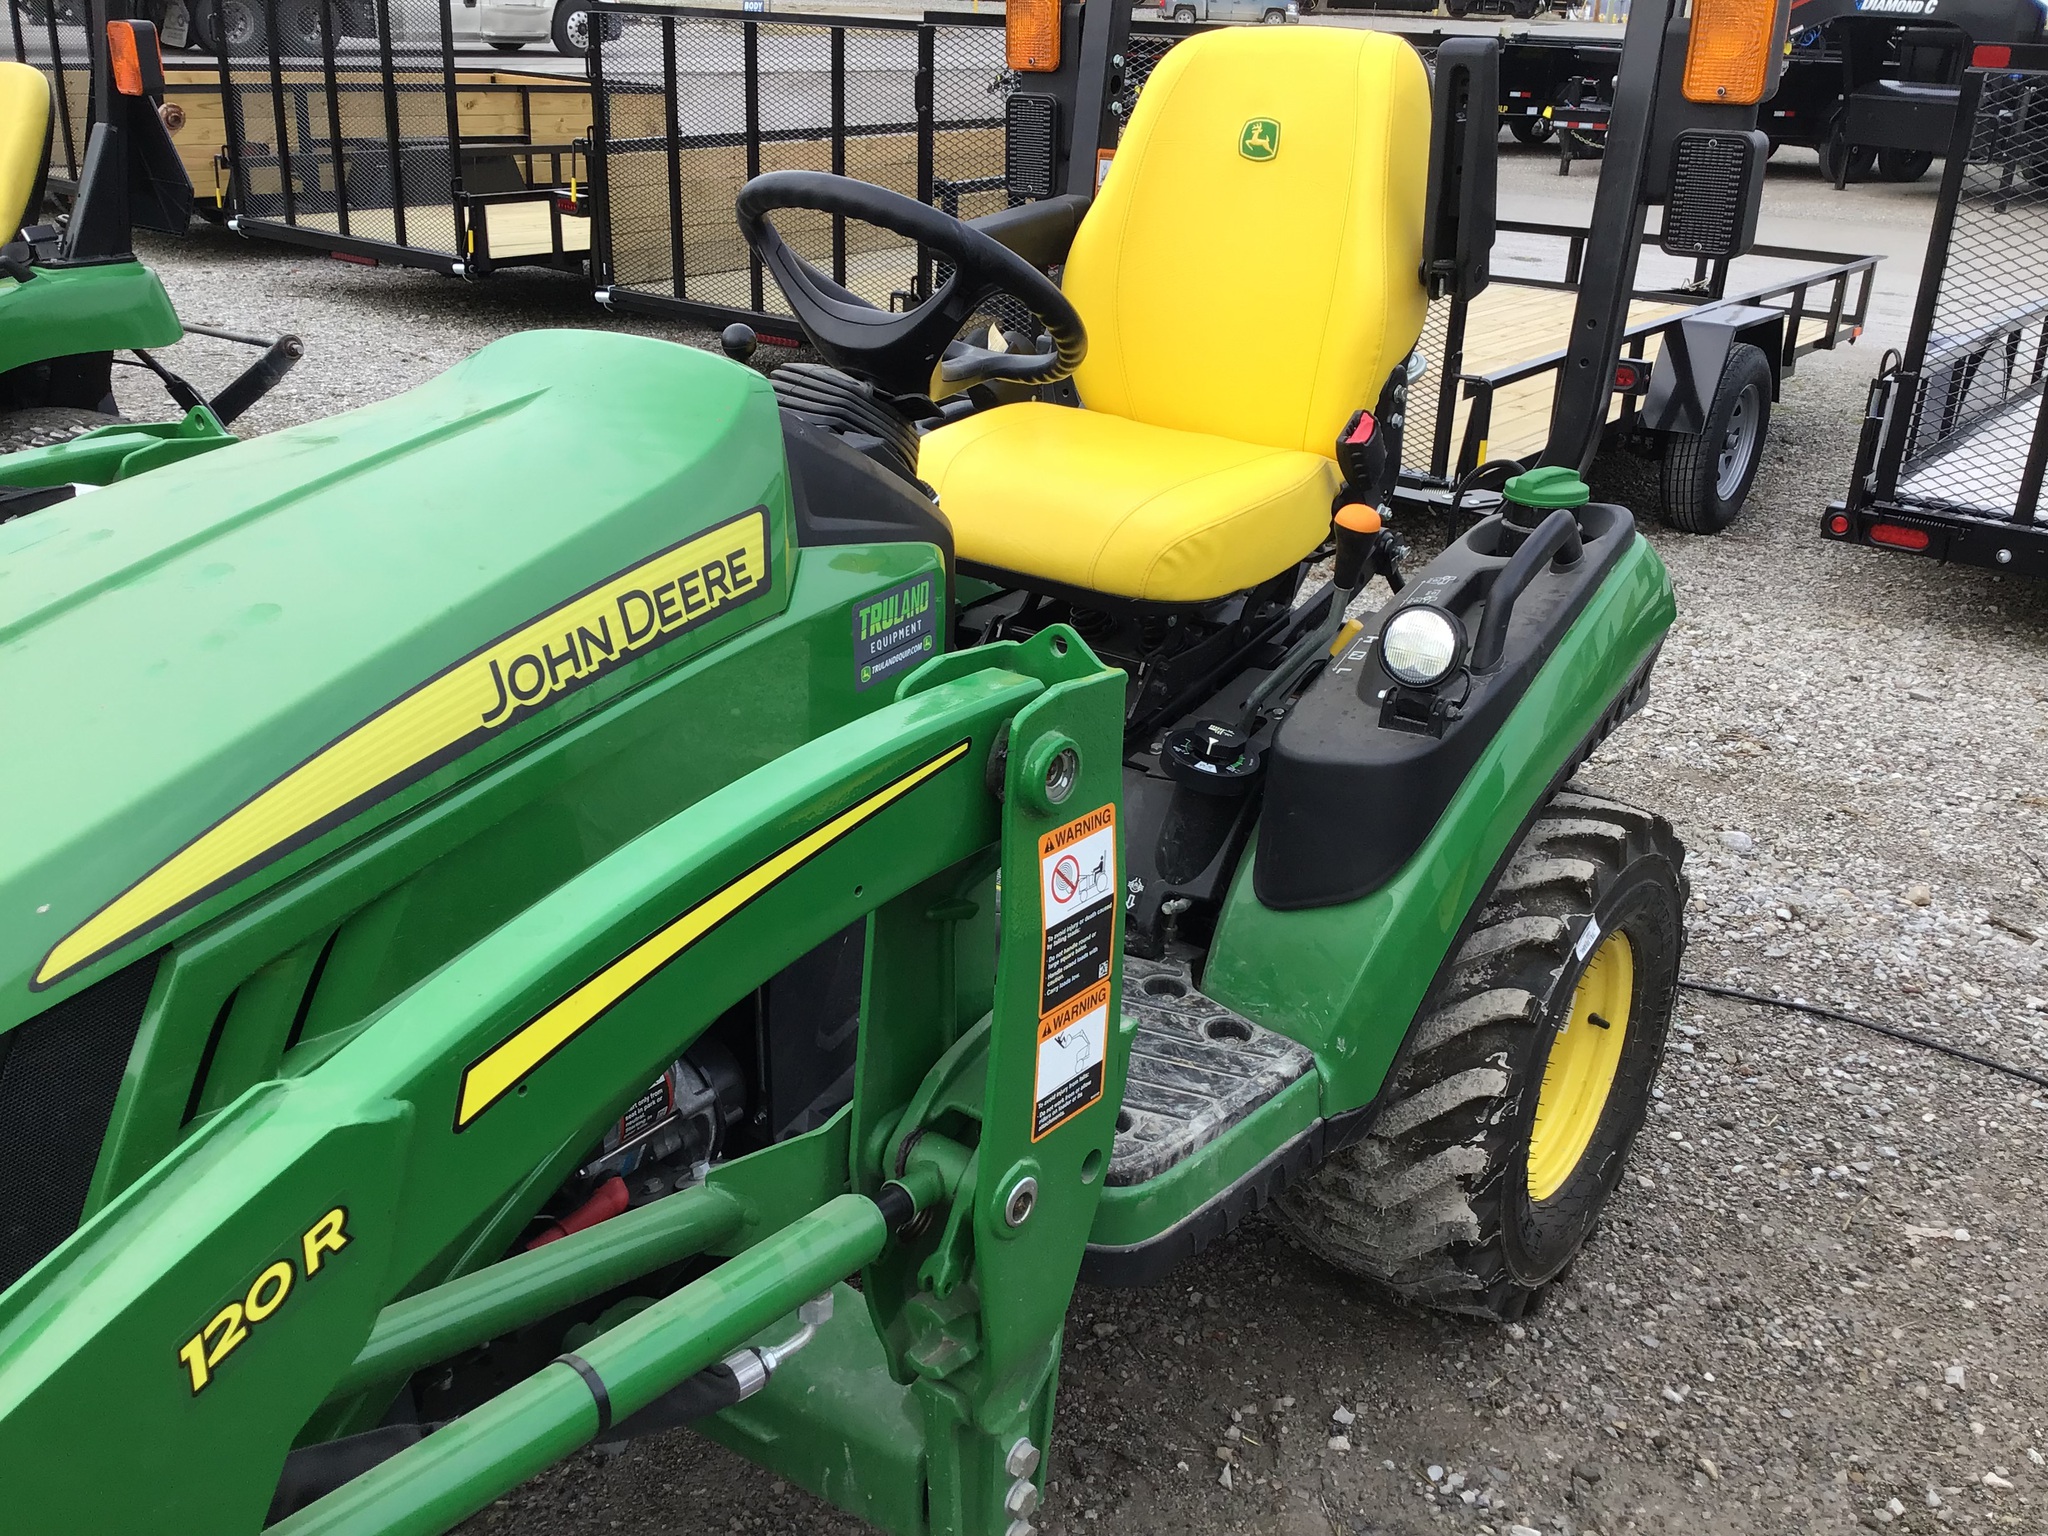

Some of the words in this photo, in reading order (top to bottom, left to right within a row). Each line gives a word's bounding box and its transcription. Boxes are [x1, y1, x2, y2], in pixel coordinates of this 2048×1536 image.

[744, 1, 763, 10] BODY
[1861, 0, 1923, 13] DIAMOND
[1924, 0, 1938, 14] C
[859, 581, 930, 640] TRULAND
[482, 615, 616, 726] JOHN
[616, 547, 753, 645] DEERE
[870, 619, 922, 654] EQUIPMENT
[872, 642, 922, 675] TRULANDEQUIP.COM
[1055, 808, 1111, 847] WARNING
[1053, 928, 1066, 939] avoid
[1067, 922, 1078, 932] injury
[1085, 911, 1096, 921] death
[1097, 902, 1112, 915] caused
[1063, 943, 1078, 954] handle
[1079, 934, 1091, 945] round
[1047, 968, 1063, 980] Handle
[1089, 946, 1098, 955] with
[1048, 960, 1059, 970] large
[1047, 985, 1059, 996] Carry
[1053, 988, 1106, 1030] WARNING
[638, 1096, 650, 1106] only
[650, 1088, 663, 1099] from
[1044, 1094, 1056, 1106] avoid
[1056, 1086, 1068, 1097] injury
[1081, 1080, 1092, 1090] allow
[625, 1110, 637, 1121] seat
[644, 1100, 656, 1111] park
[180, 1260, 293, 1393] 120
[302, 1207, 348, 1277] R
